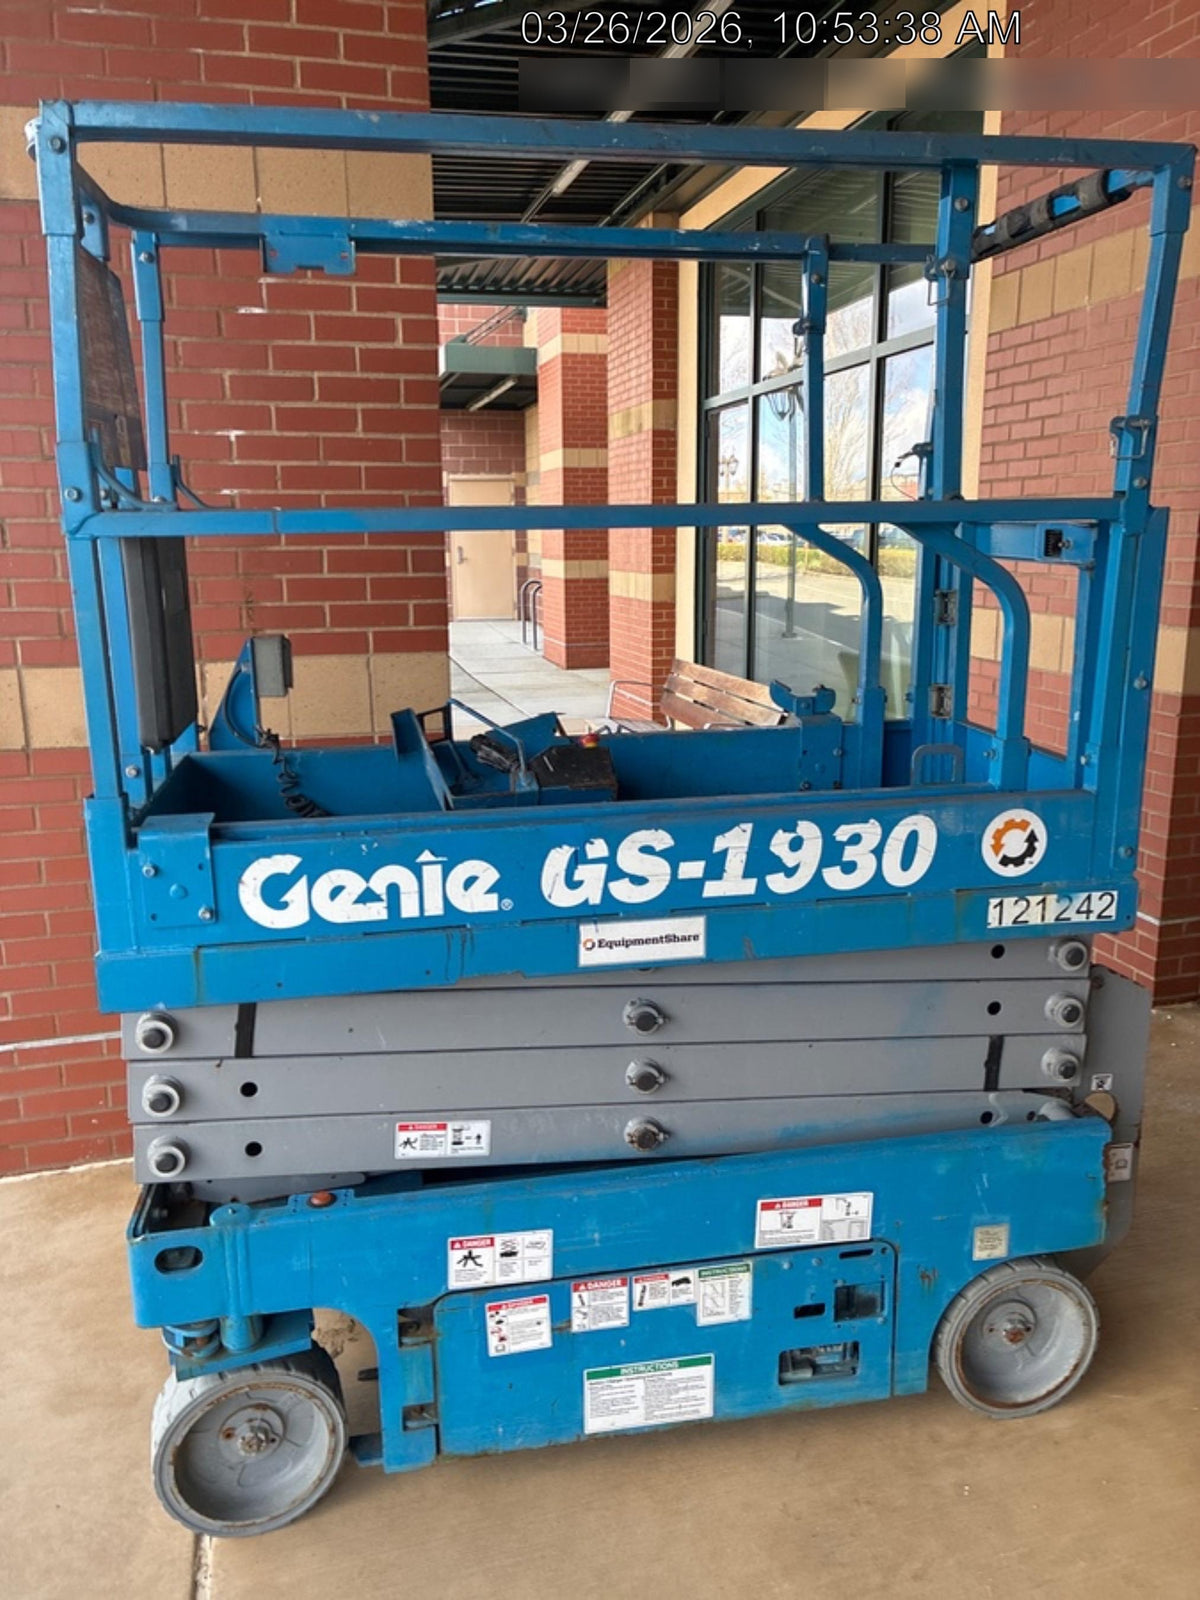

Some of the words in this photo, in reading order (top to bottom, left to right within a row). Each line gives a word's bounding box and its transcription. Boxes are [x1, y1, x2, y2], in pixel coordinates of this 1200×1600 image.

[540, 814, 938, 909] GS-1930
[992, 892, 1115, 925] 121242
[597, 933, 698, 949] EquipmentShare
[586, 1279, 623, 1291] DANGER
[620, 1360, 680, 1376] INSTRUCTIONS
